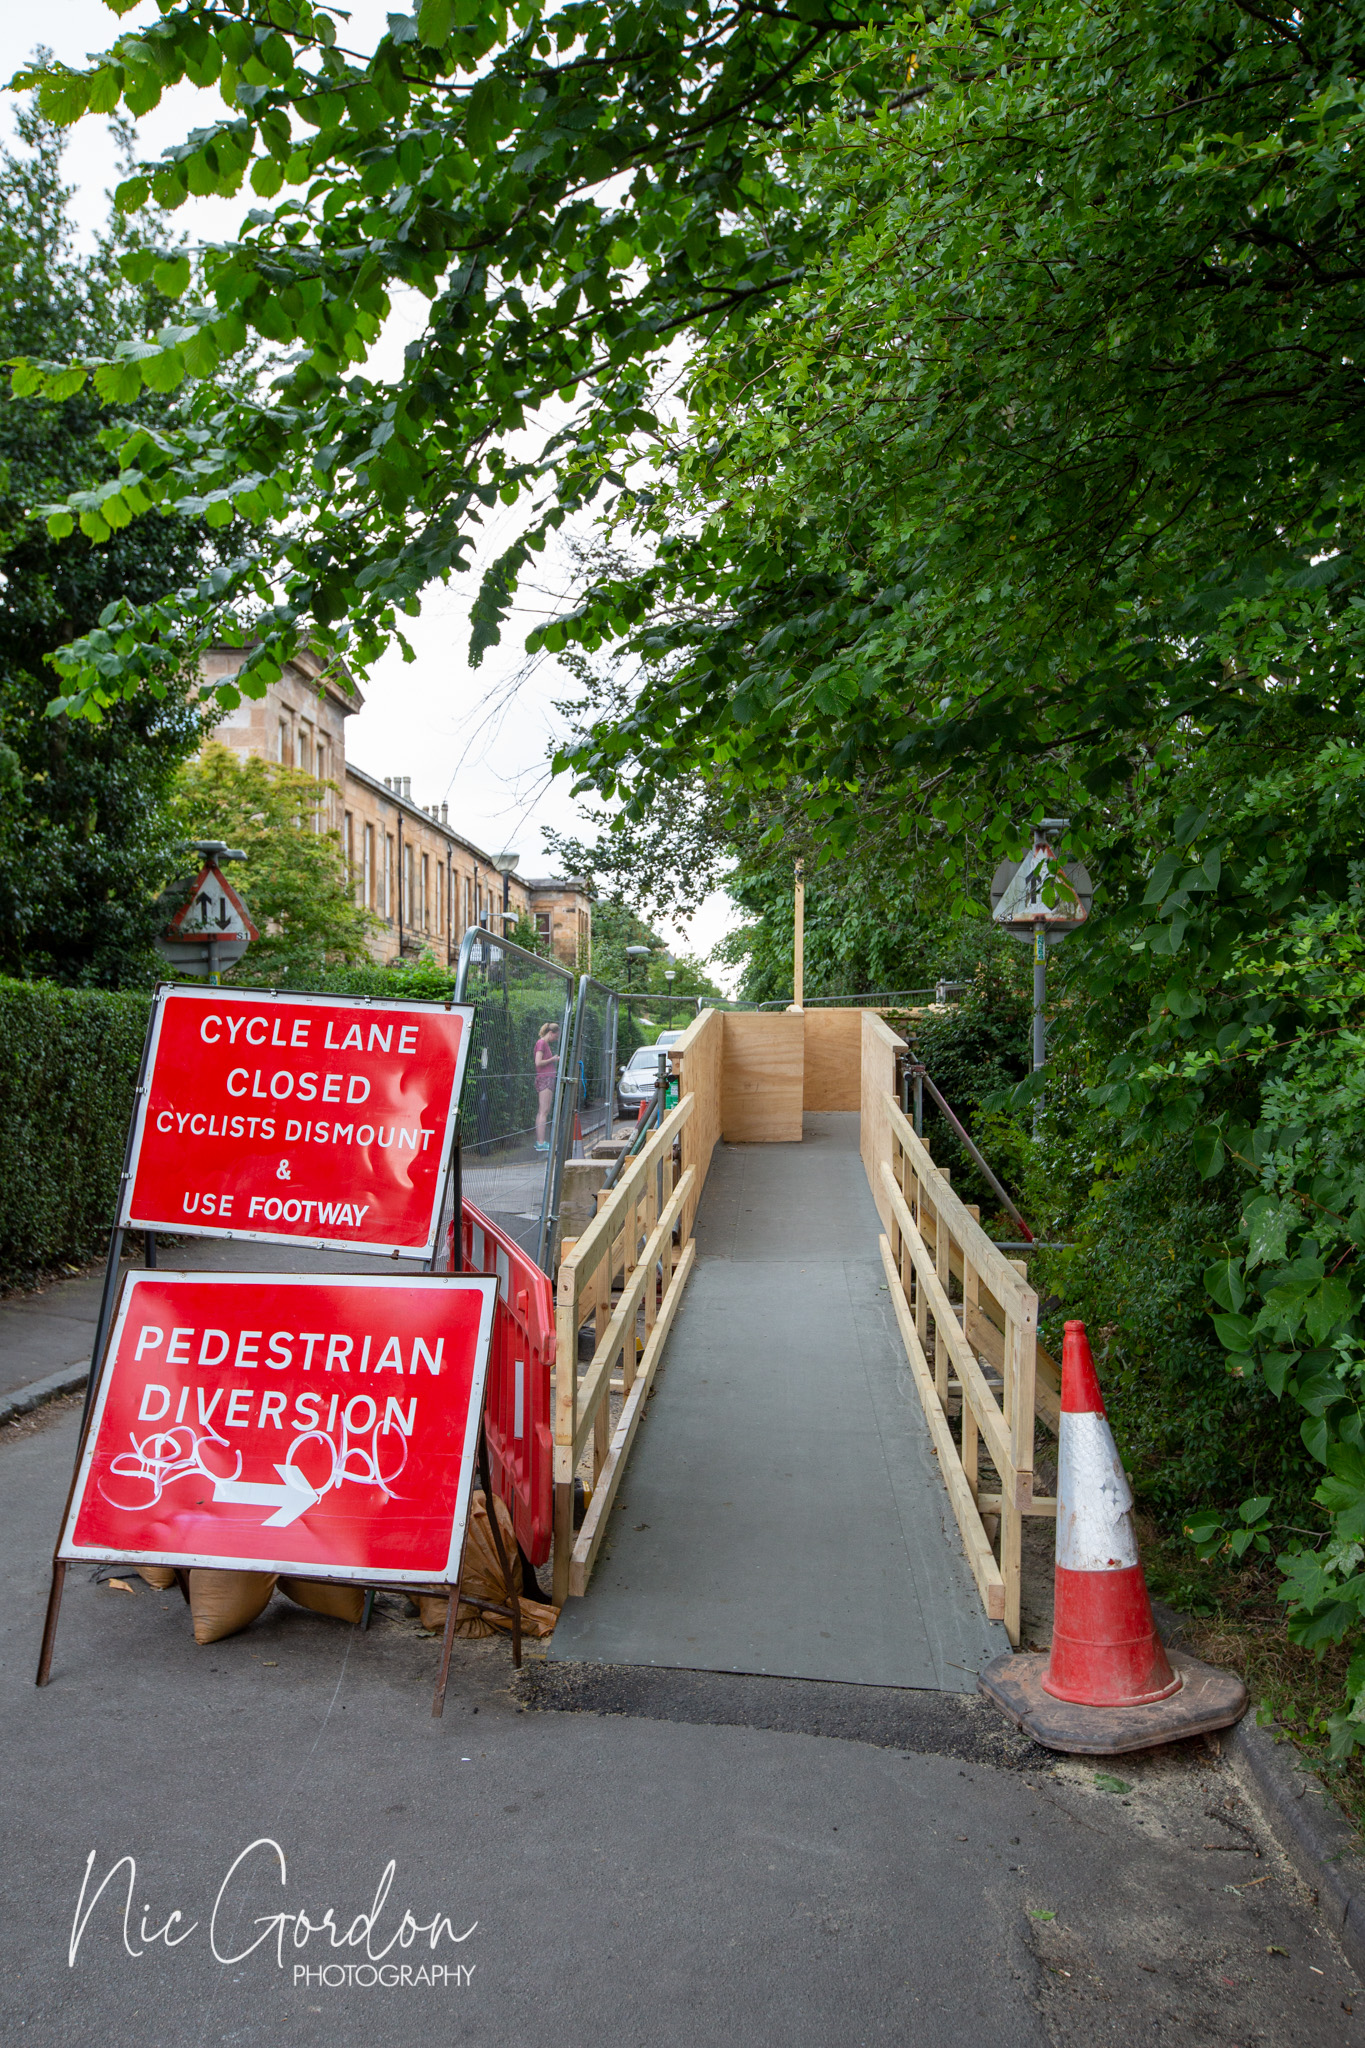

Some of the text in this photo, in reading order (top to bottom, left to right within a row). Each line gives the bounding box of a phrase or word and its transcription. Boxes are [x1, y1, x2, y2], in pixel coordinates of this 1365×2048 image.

[200, 1014, 419, 1054] CYCLE LANE
[226, 1067, 371, 1104] CLOSED
[156, 1110, 435, 1151] CYCLISTS DISMOUNT
[276, 1159, 291, 1181] &
[182, 1192, 370, 1227] USE FOOTWAY
[134, 1325, 445, 1376] PEDESTRIAN
[137, 1383, 418, 1436] DIVERSION
